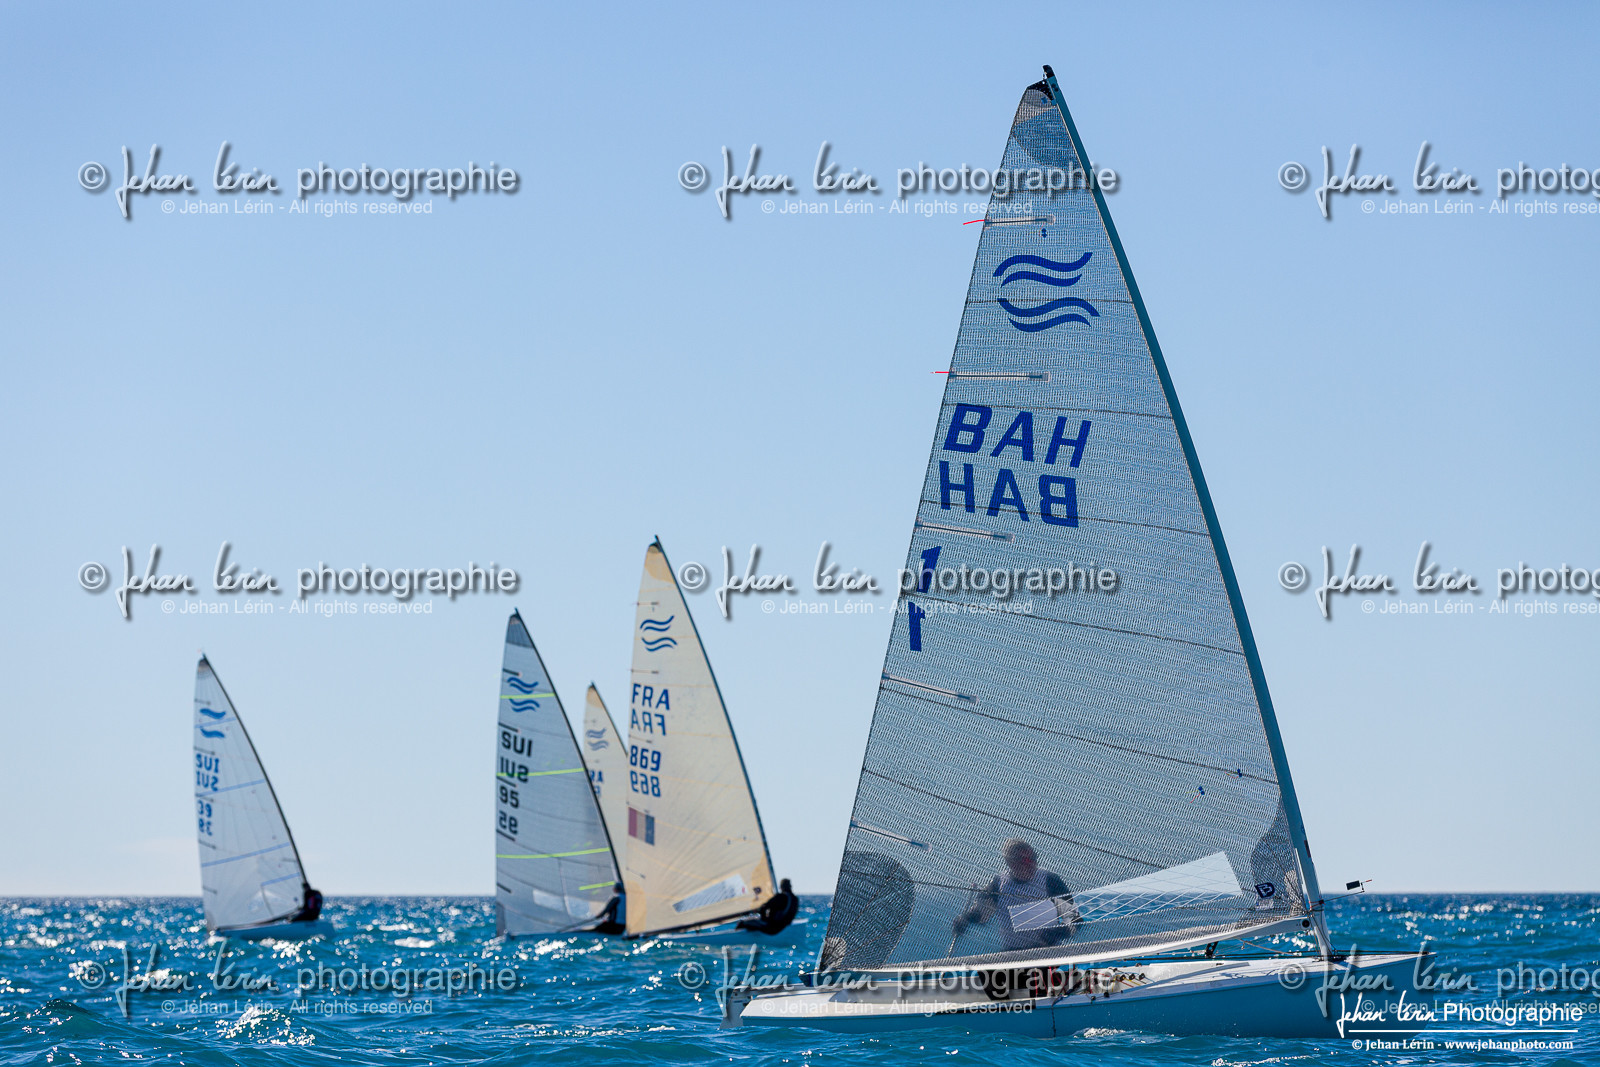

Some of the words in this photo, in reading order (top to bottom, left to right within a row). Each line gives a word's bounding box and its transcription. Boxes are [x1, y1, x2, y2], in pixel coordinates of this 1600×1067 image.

[943, 402, 1092, 468] BAH
[916, 546, 942, 594] 1
[632, 683, 670, 711] FRA
[501, 731, 533, 757] SUI
[630, 745, 661, 772] 869
[500, 786, 519, 809] 95
